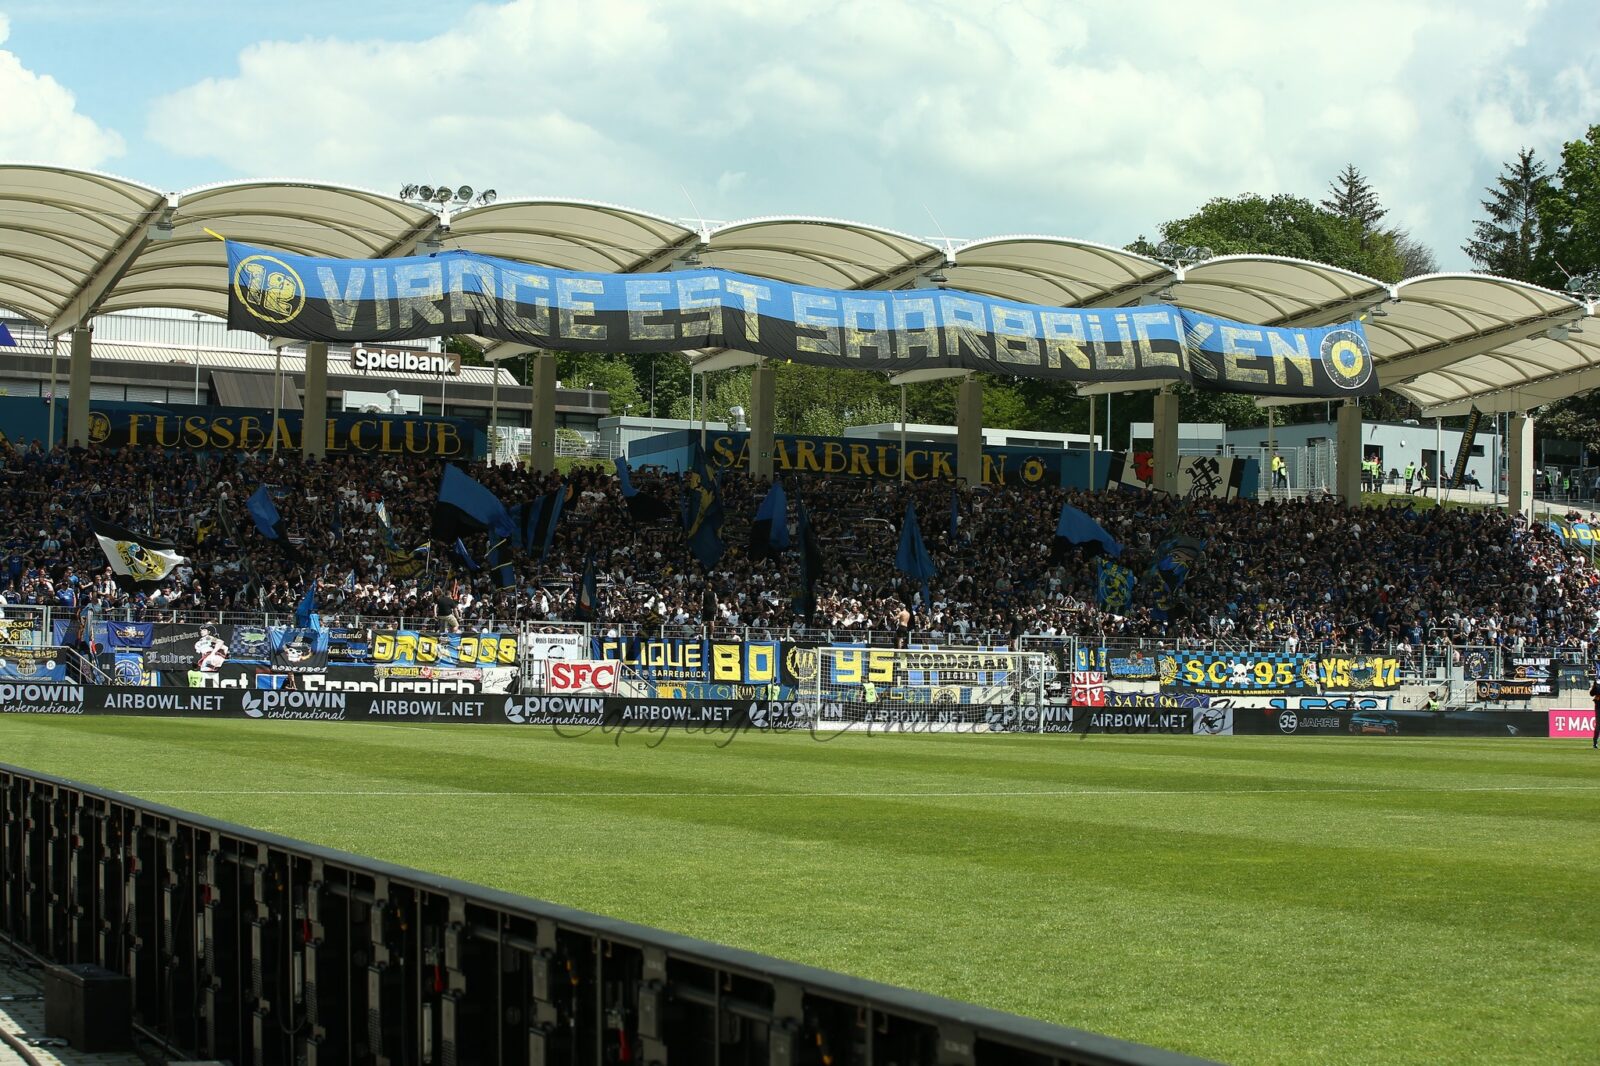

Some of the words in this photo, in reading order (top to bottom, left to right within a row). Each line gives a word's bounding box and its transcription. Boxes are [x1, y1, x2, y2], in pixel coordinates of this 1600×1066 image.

[316, 259, 607, 340] VIRAGE
[624, 276, 771, 342] EST
[355, 349, 456, 372] Spielbank
[128, 414, 347, 450] FUSSBAL
[351, 420, 461, 454] CLUB
[711, 436, 1007, 485] SAARBRÜCKN
[602, 642, 702, 667] CLIQUE
[551, 663, 613, 689] SFC
[651, 669, 707, 678] SARREBRUCK
[1185, 660, 1228, 683] SC
[1253, 662, 1295, 685] 95
[1373, 657, 1397, 687] 17
[4, 701, 83, 714] international
[104, 693, 224, 710] AIRBOWL.NET
[368, 700, 485, 716] AIRBOWL.NET
[268, 707, 345, 720] international
[529, 713, 604, 725] international
[622, 705, 733, 721] AIRBOWL.NET
[864, 709, 967, 725] AIRBOWLNET
[1090, 713, 1187, 728] AIRBOWL.NET
[1280, 714, 1297, 728] 35
[1300, 717, 1340, 728] JAHRE
